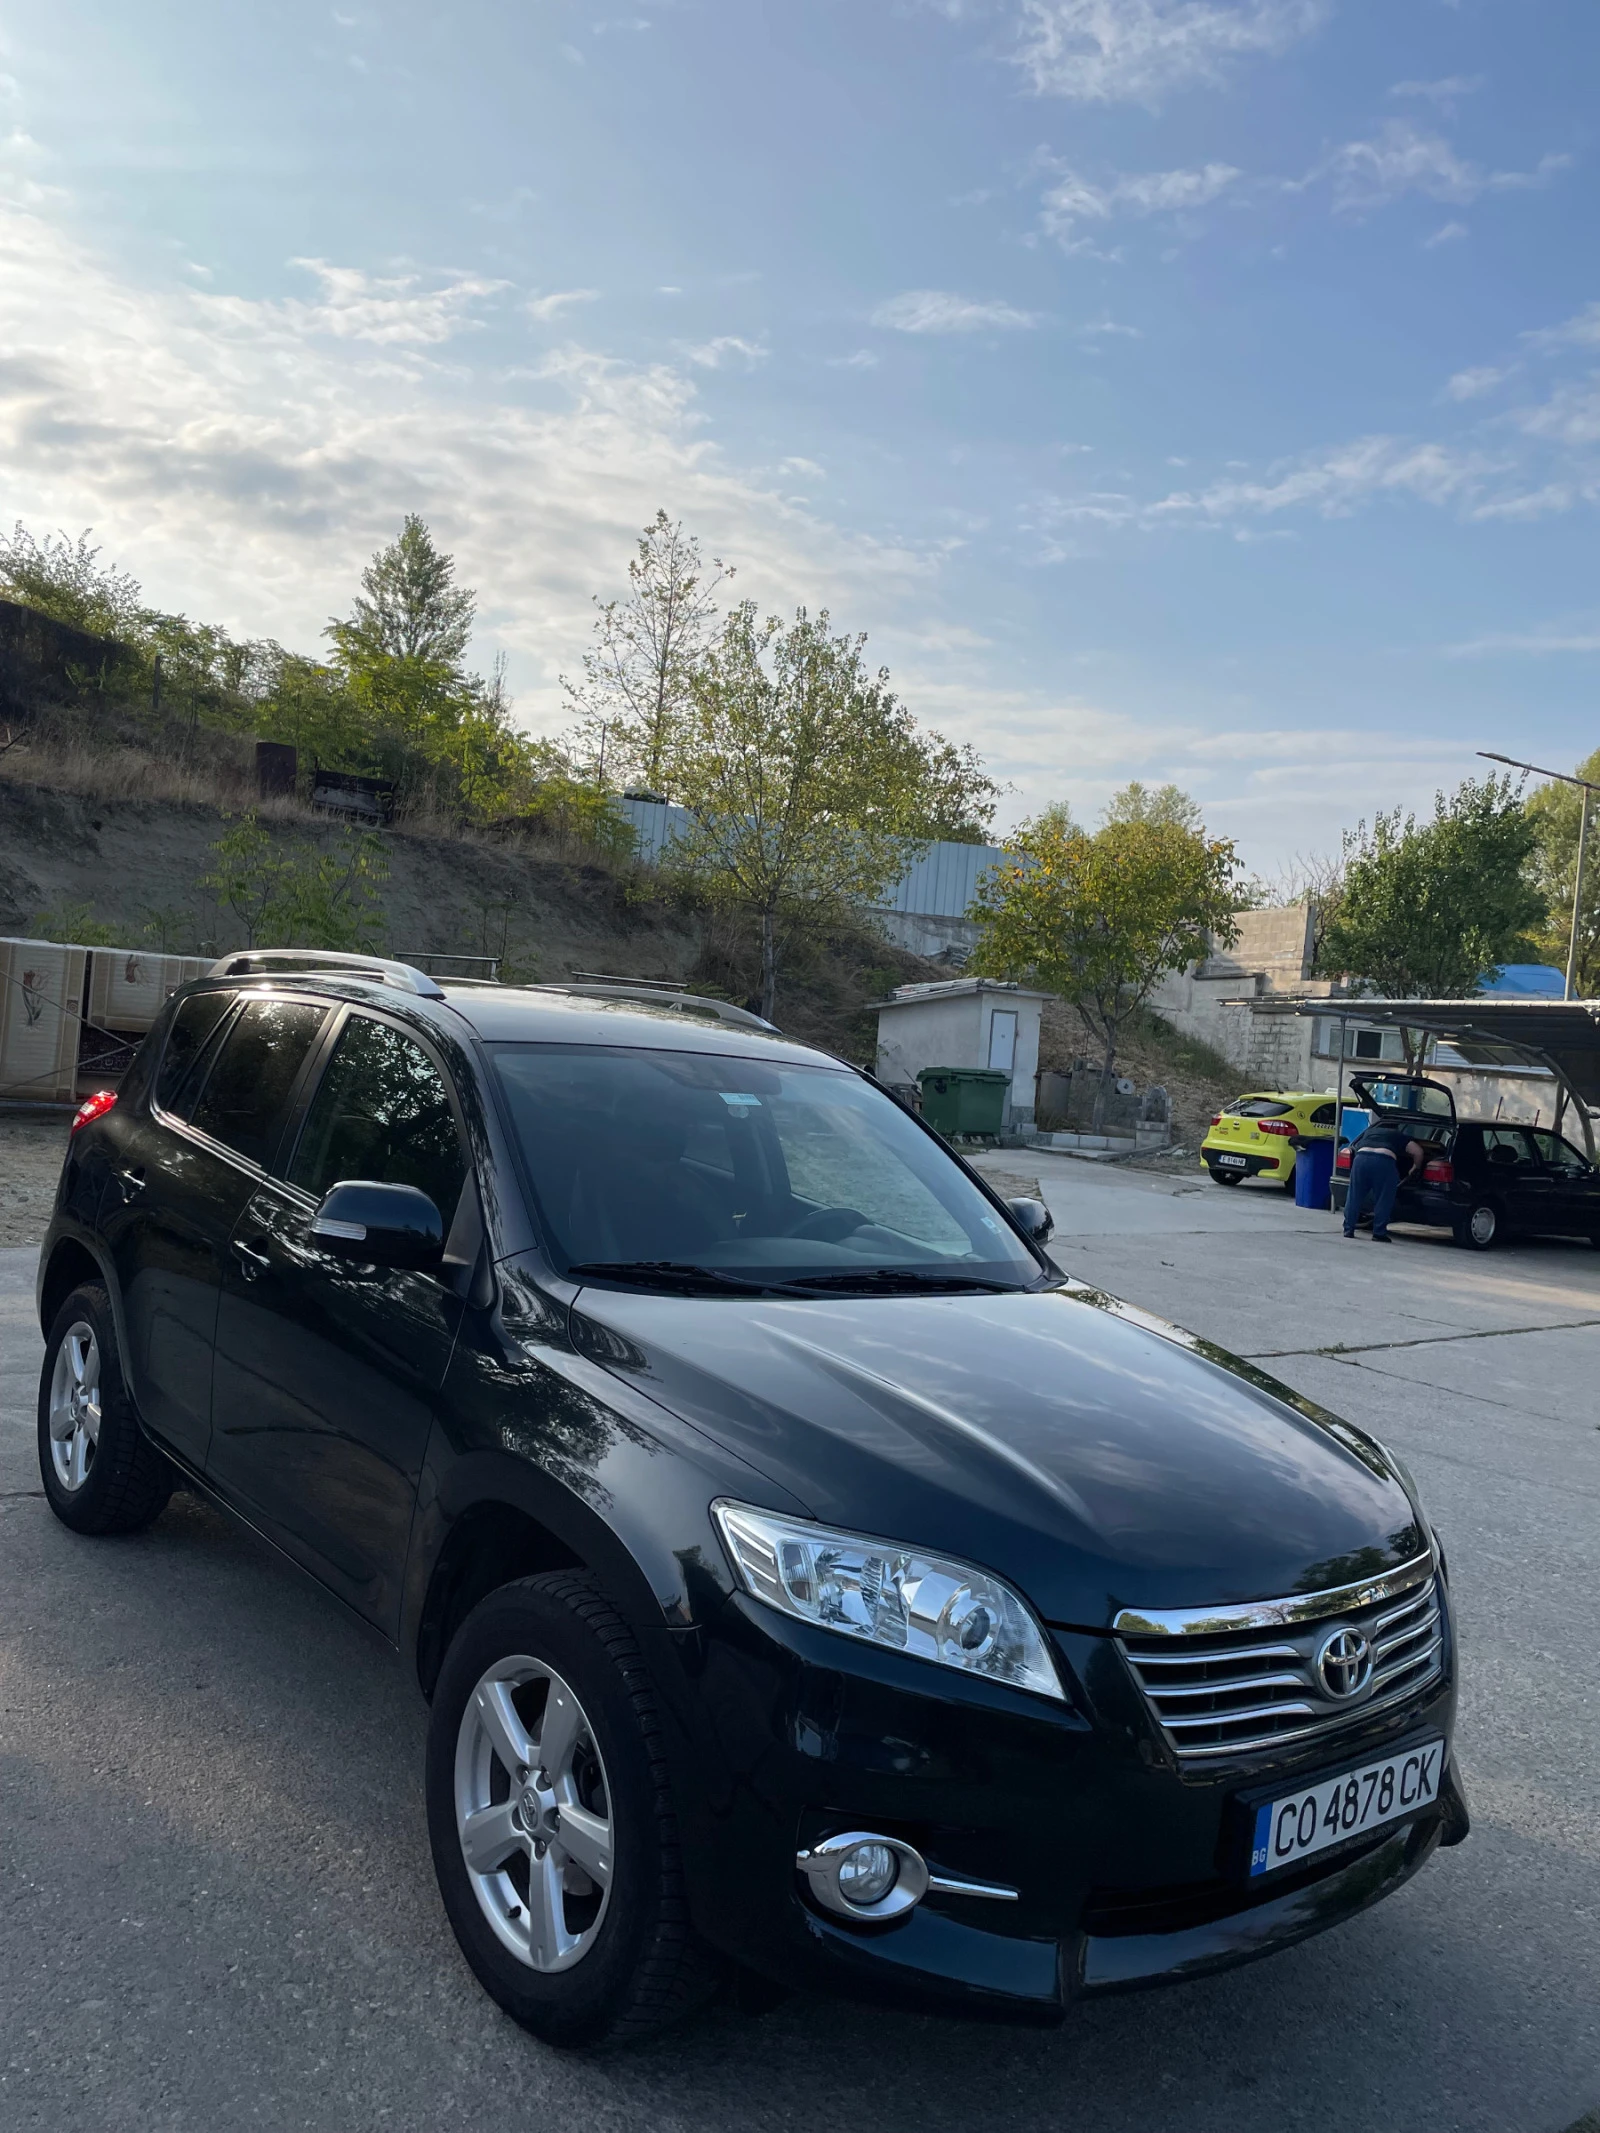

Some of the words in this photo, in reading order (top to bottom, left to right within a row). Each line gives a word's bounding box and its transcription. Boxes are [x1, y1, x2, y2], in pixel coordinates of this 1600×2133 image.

[1275, 1795, 1317, 1857] CO
[1323, 1766, 1396, 1836] 4878
[1400, 1748, 1438, 1805] CK
[1251, 1847, 1267, 1867] BG
